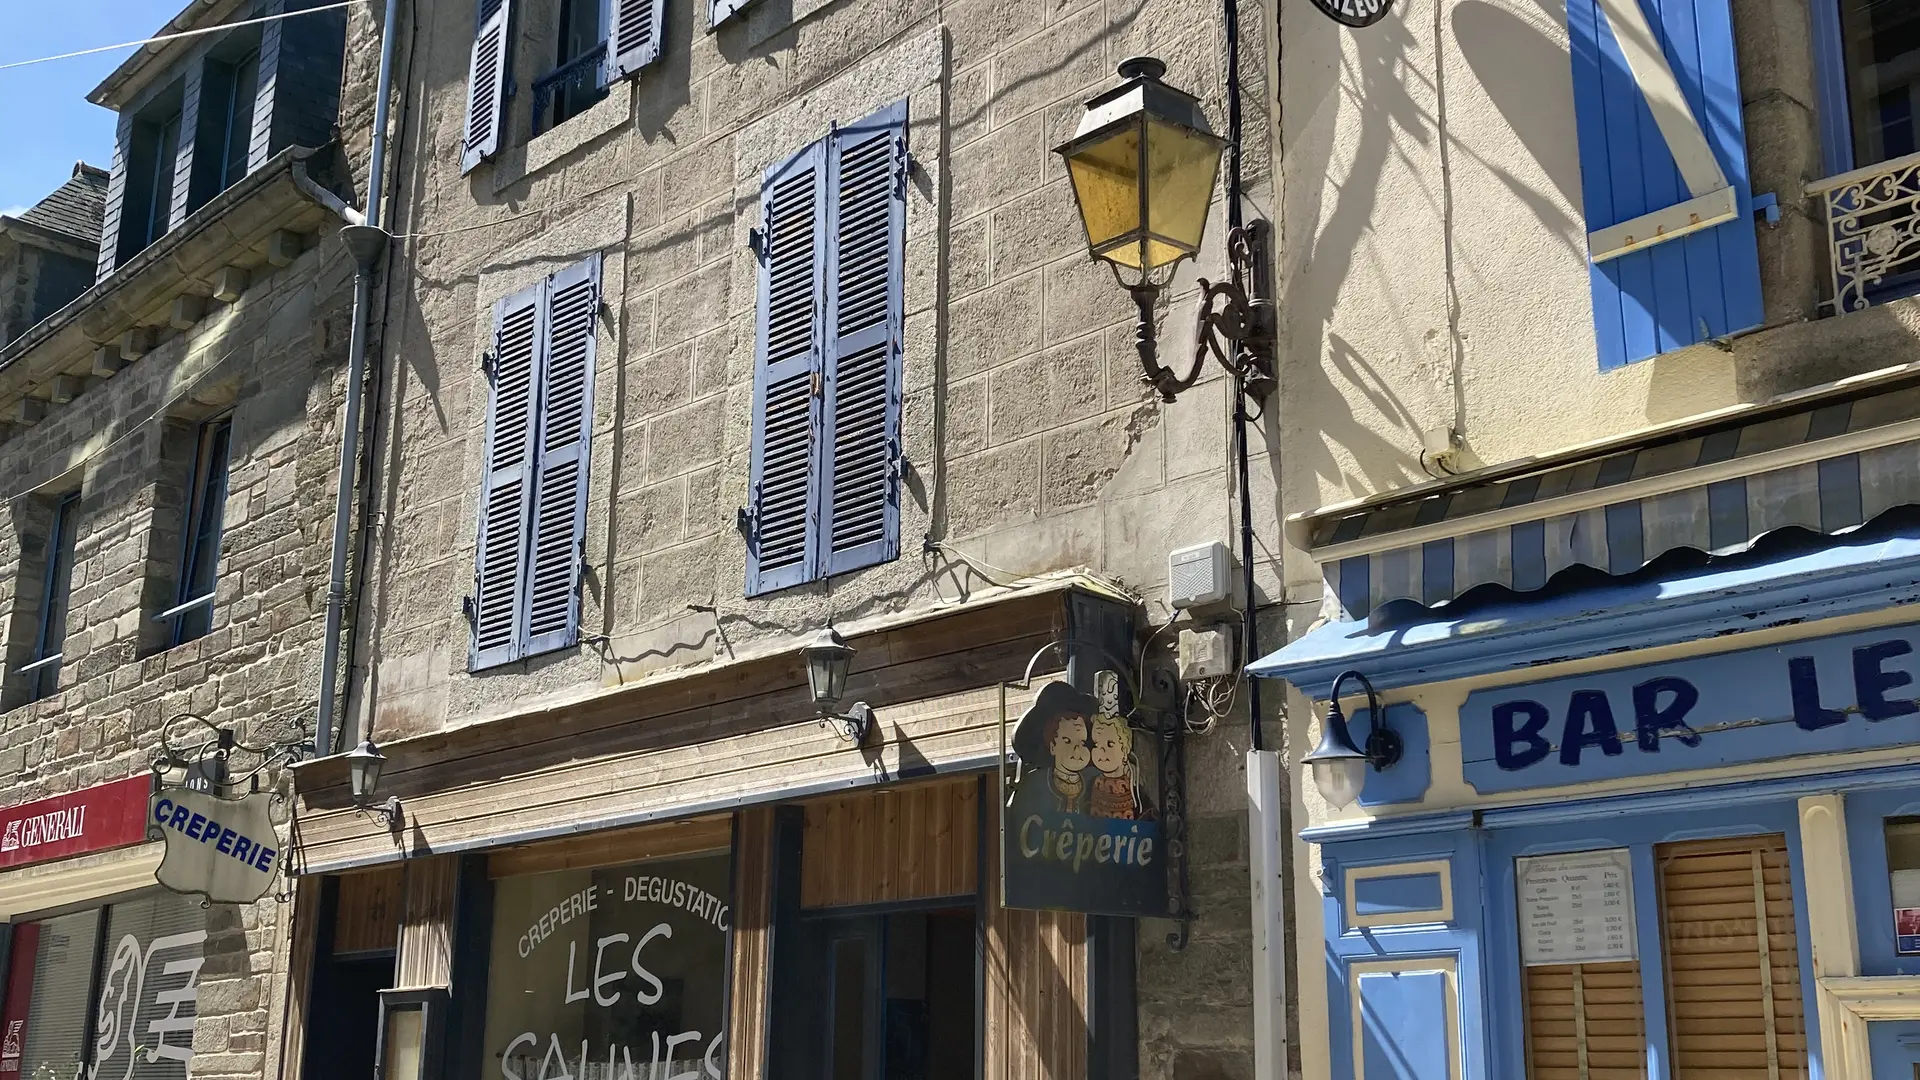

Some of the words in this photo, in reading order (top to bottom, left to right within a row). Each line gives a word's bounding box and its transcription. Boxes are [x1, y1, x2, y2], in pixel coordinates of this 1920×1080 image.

[1492, 675, 1703, 771] BAR
[1787, 639, 1920, 731] LE
[21, 805, 86, 847] GENERALI
[154, 799, 276, 873] CREPERIE
[1020, 814, 1153, 874] Crêperie
[518, 885, 598, 958] CREPERIE
[565, 923, 672, 1007] LES
